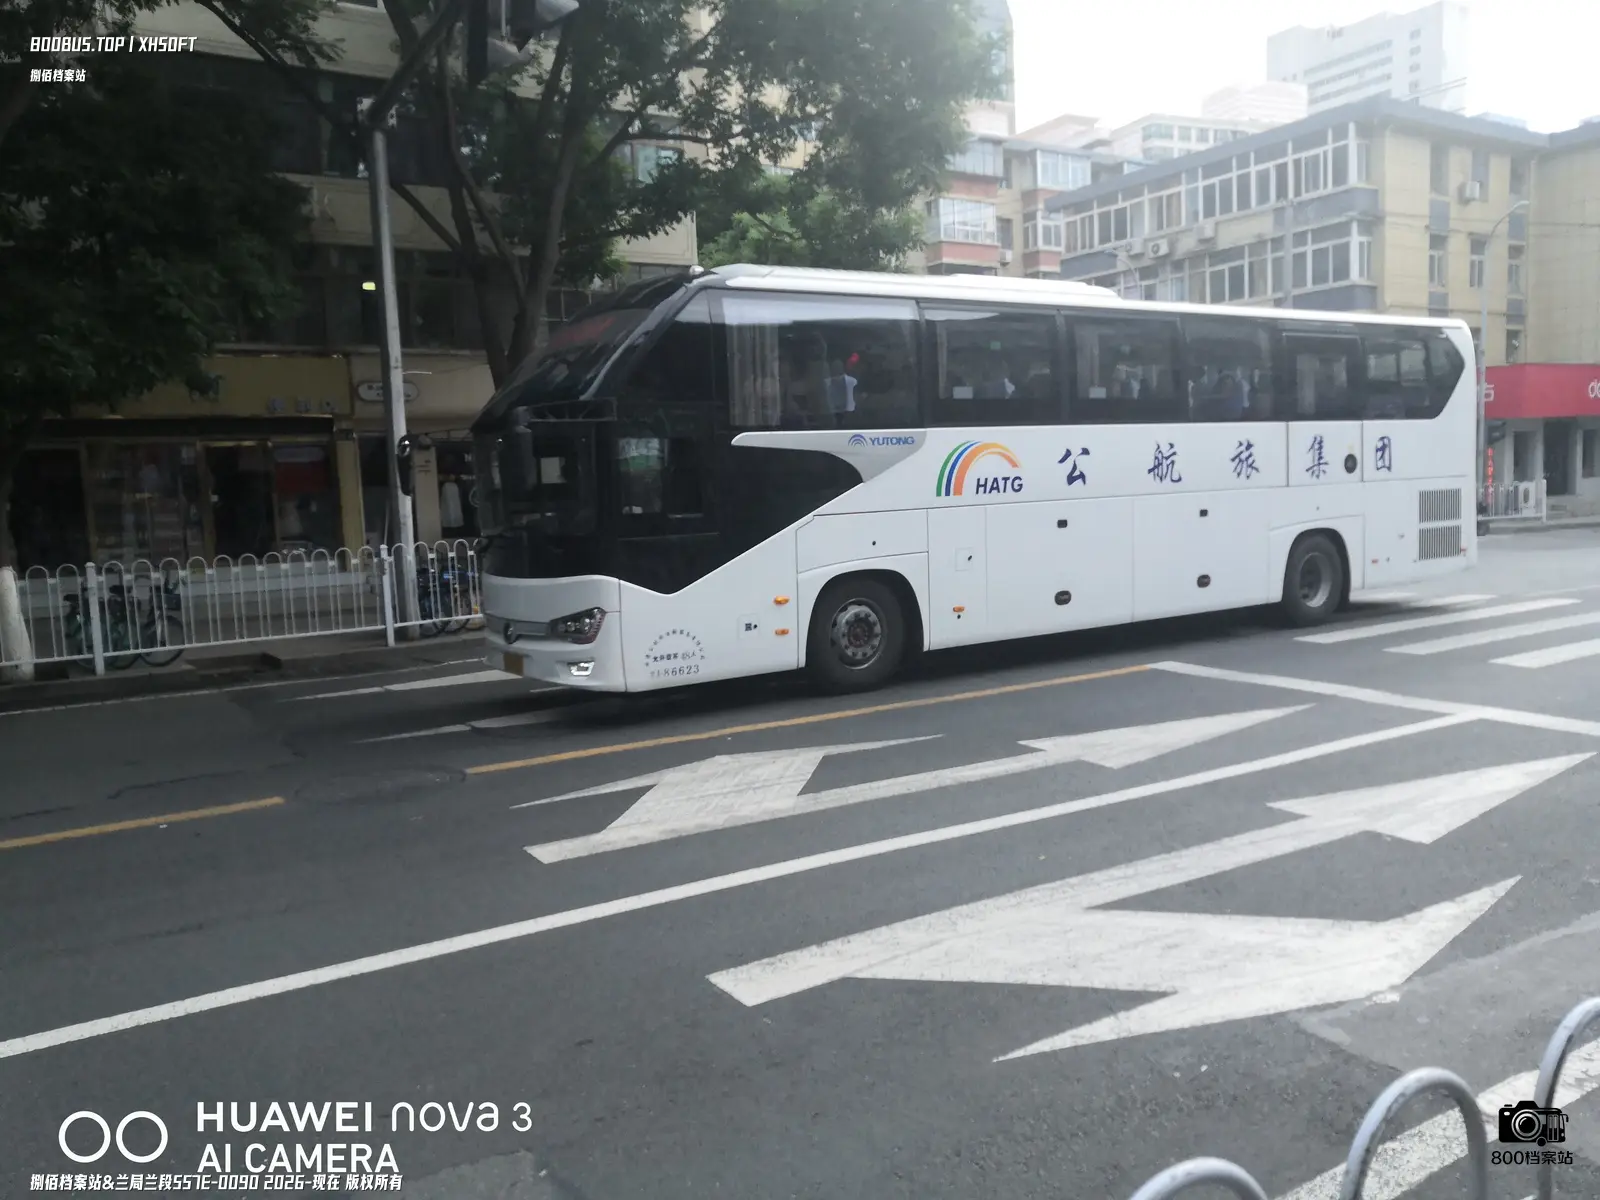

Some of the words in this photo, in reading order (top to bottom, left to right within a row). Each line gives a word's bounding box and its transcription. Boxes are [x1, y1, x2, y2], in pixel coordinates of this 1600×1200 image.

[868, 436, 915, 446] YUTONG
[1058, 434, 1393, 487] 公航旅集团
[975, 475, 1024, 495] HATG
